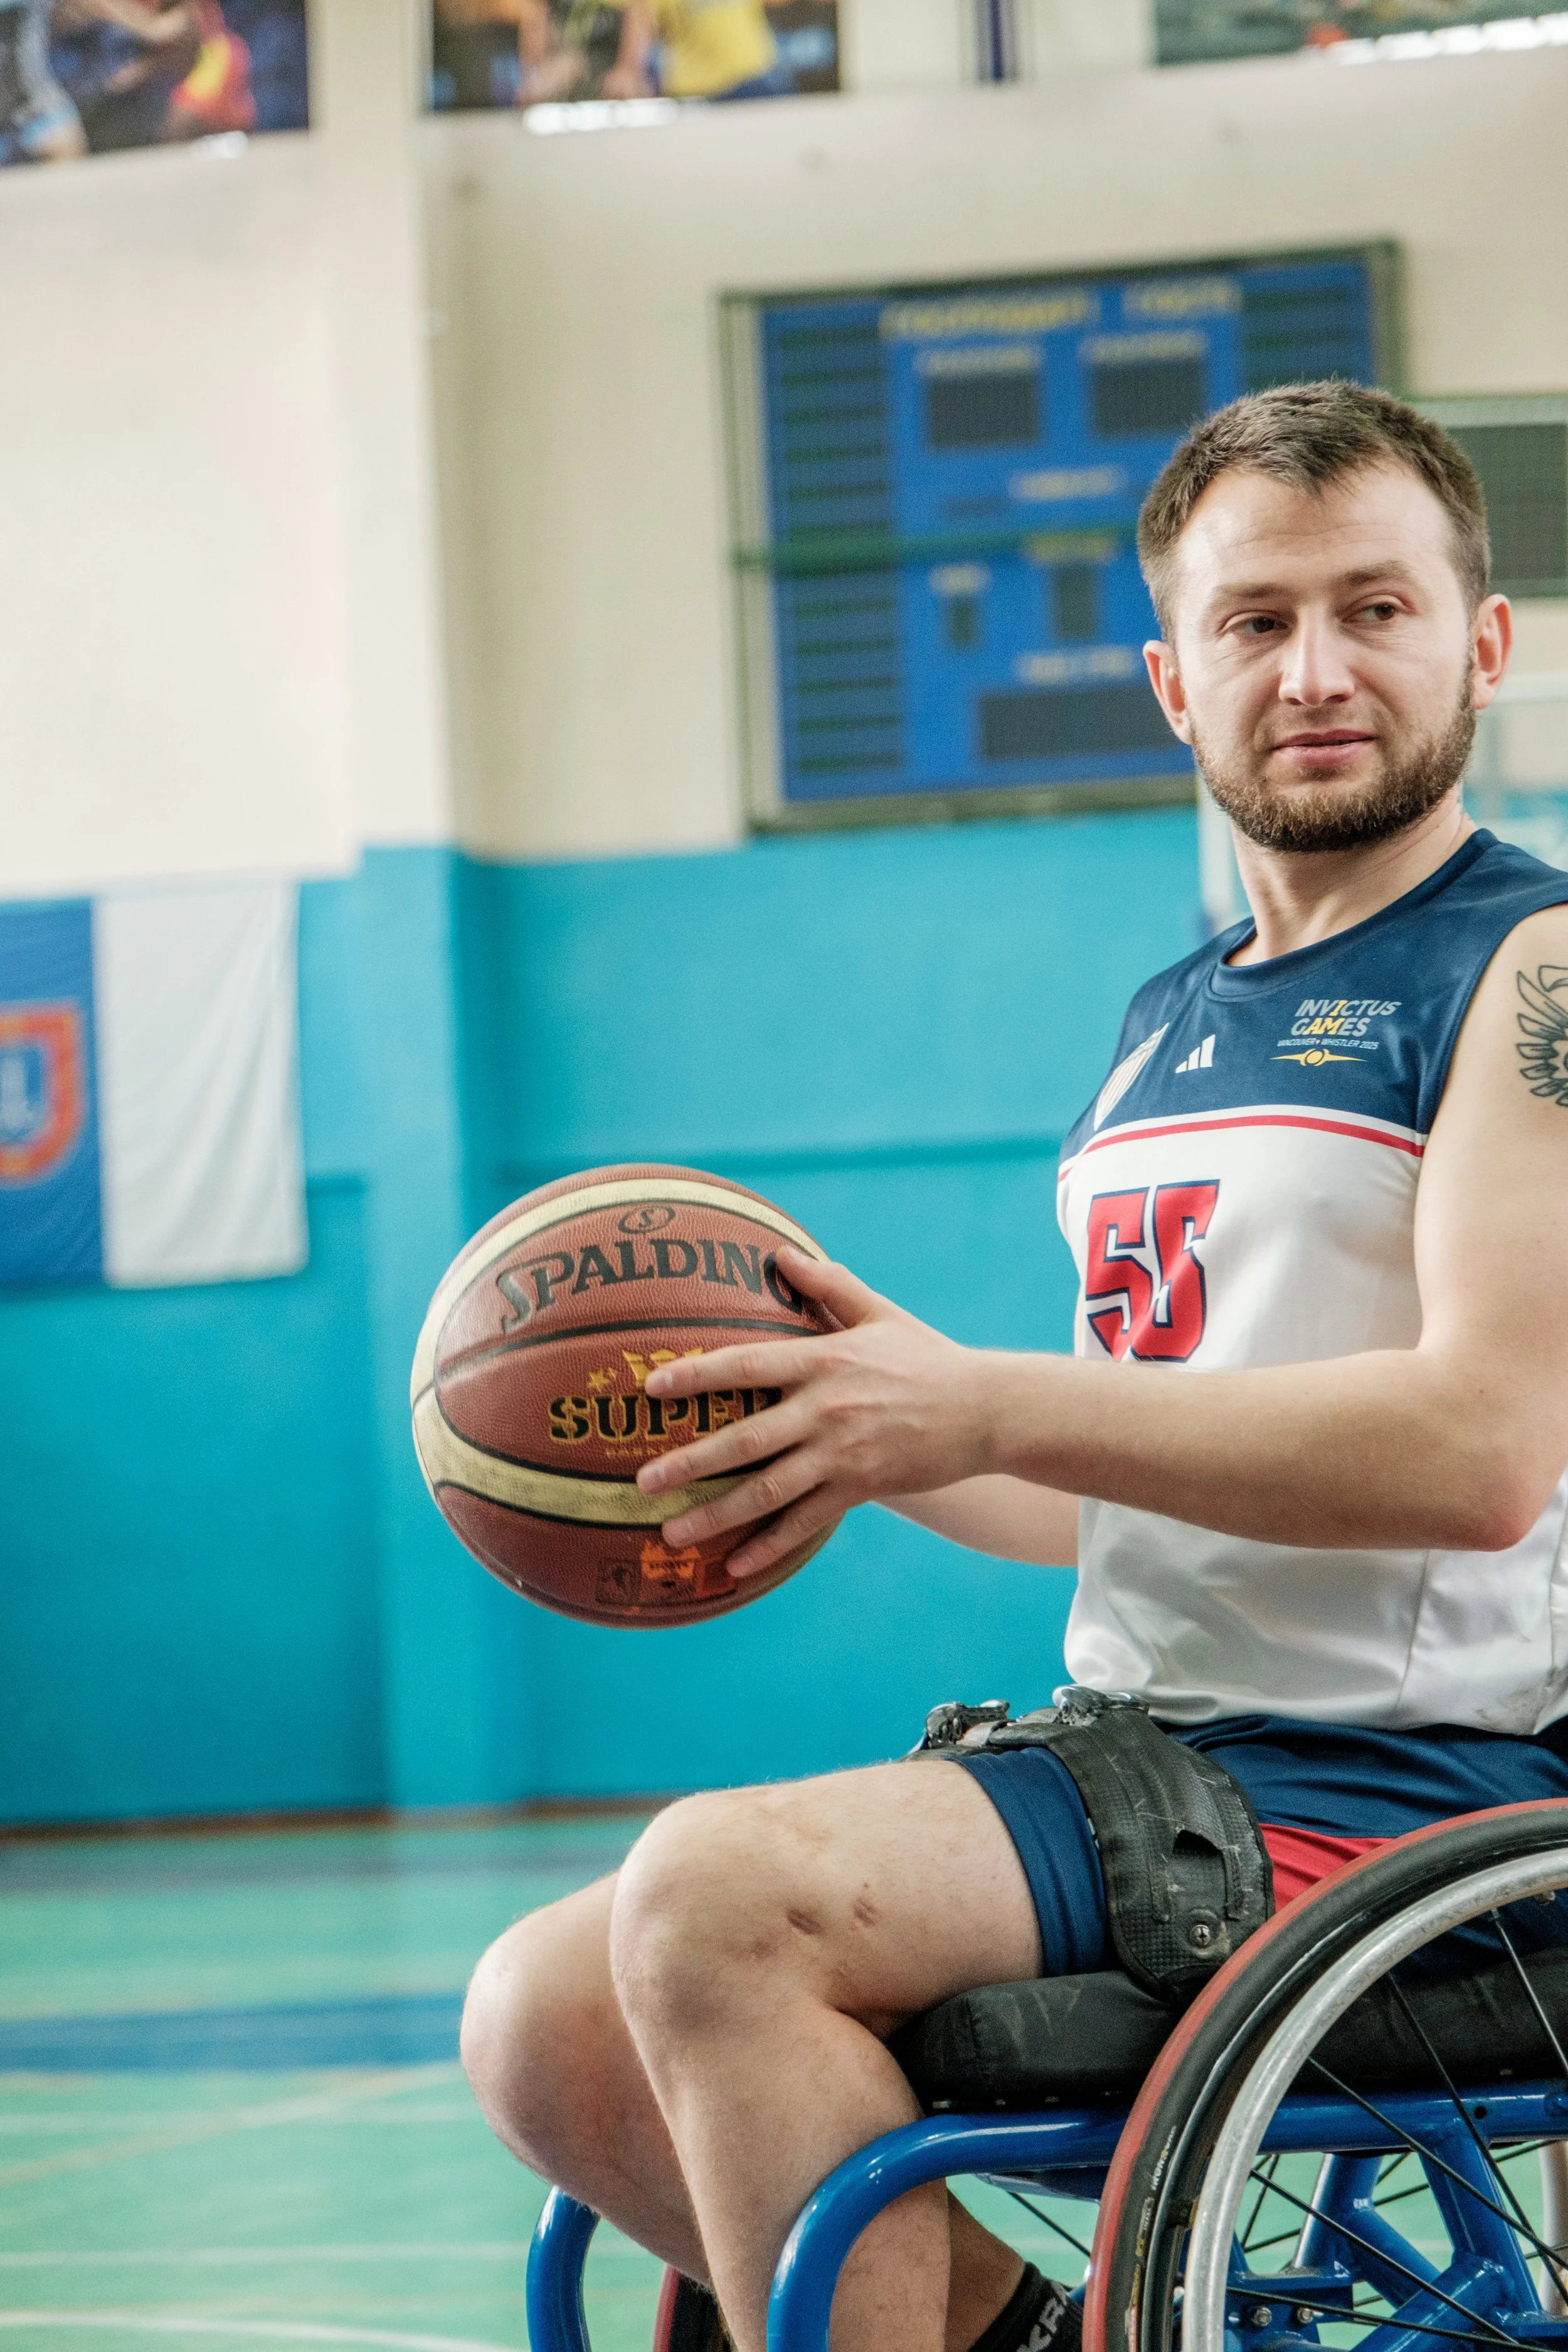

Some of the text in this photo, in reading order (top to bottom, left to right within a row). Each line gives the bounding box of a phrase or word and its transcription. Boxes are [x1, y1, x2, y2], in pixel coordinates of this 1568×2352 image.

[1295, 999, 1402, 1017] INVICTUS
[1291, 1017, 1371, 1036] GAMES
[1277, 1038, 1379, 1050] VANCOUVER WHISTLER 2025
[1086, 1179, 1220, 1363] 55
